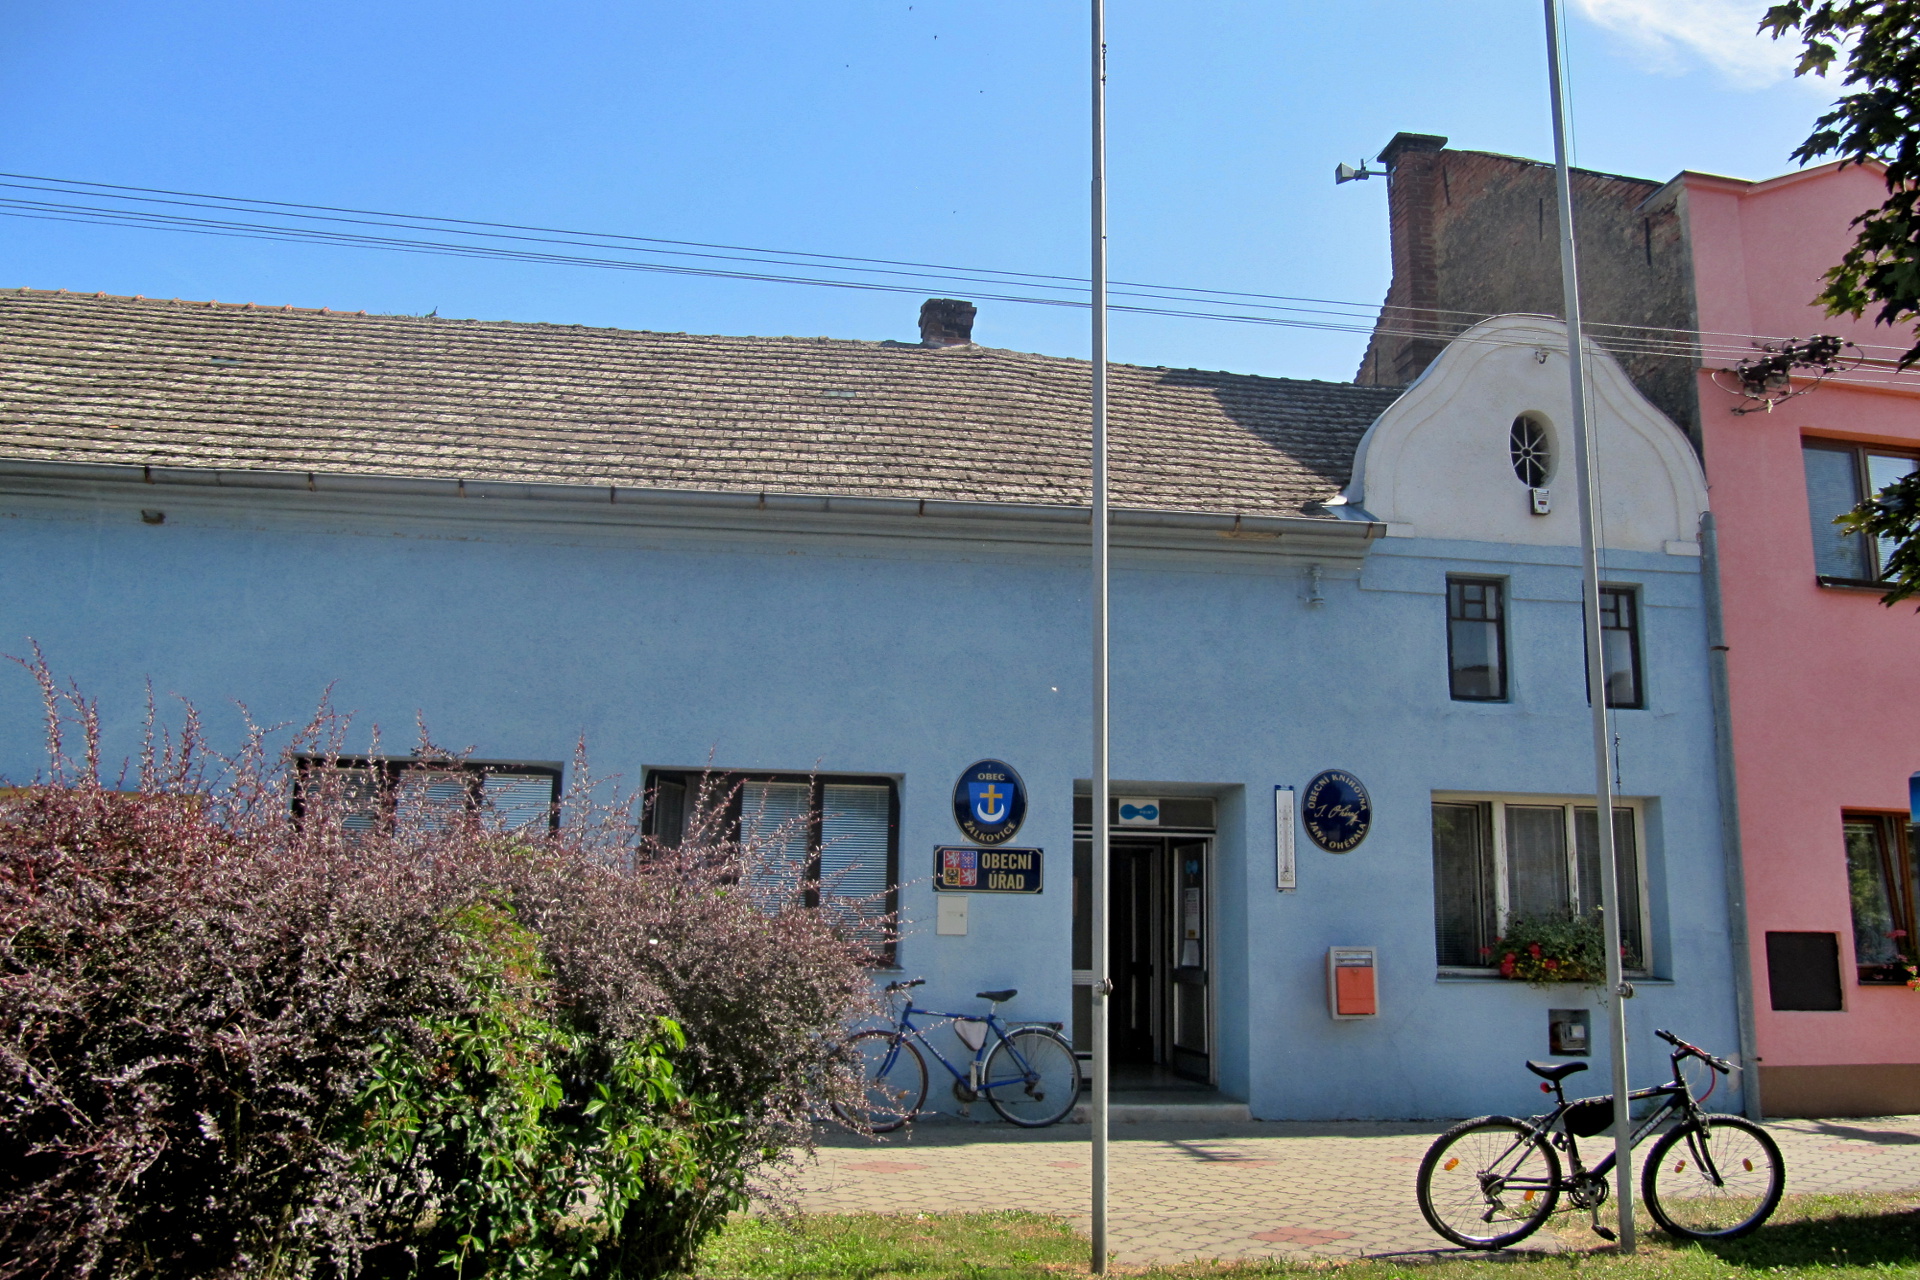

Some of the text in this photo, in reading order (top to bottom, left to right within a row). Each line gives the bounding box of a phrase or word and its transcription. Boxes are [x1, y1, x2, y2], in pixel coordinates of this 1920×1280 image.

[977, 773, 1006, 781] OBEC
[1308, 774, 1367, 811] OBECNÍ KNIHOVNA
[963, 820, 1017, 842] ŽALKOVICE
[1309, 821, 1367, 849] JANA OHÉRALA
[981, 851, 1033, 870] OBECNÍ
[988, 870, 1025, 889] ÚŘAD
